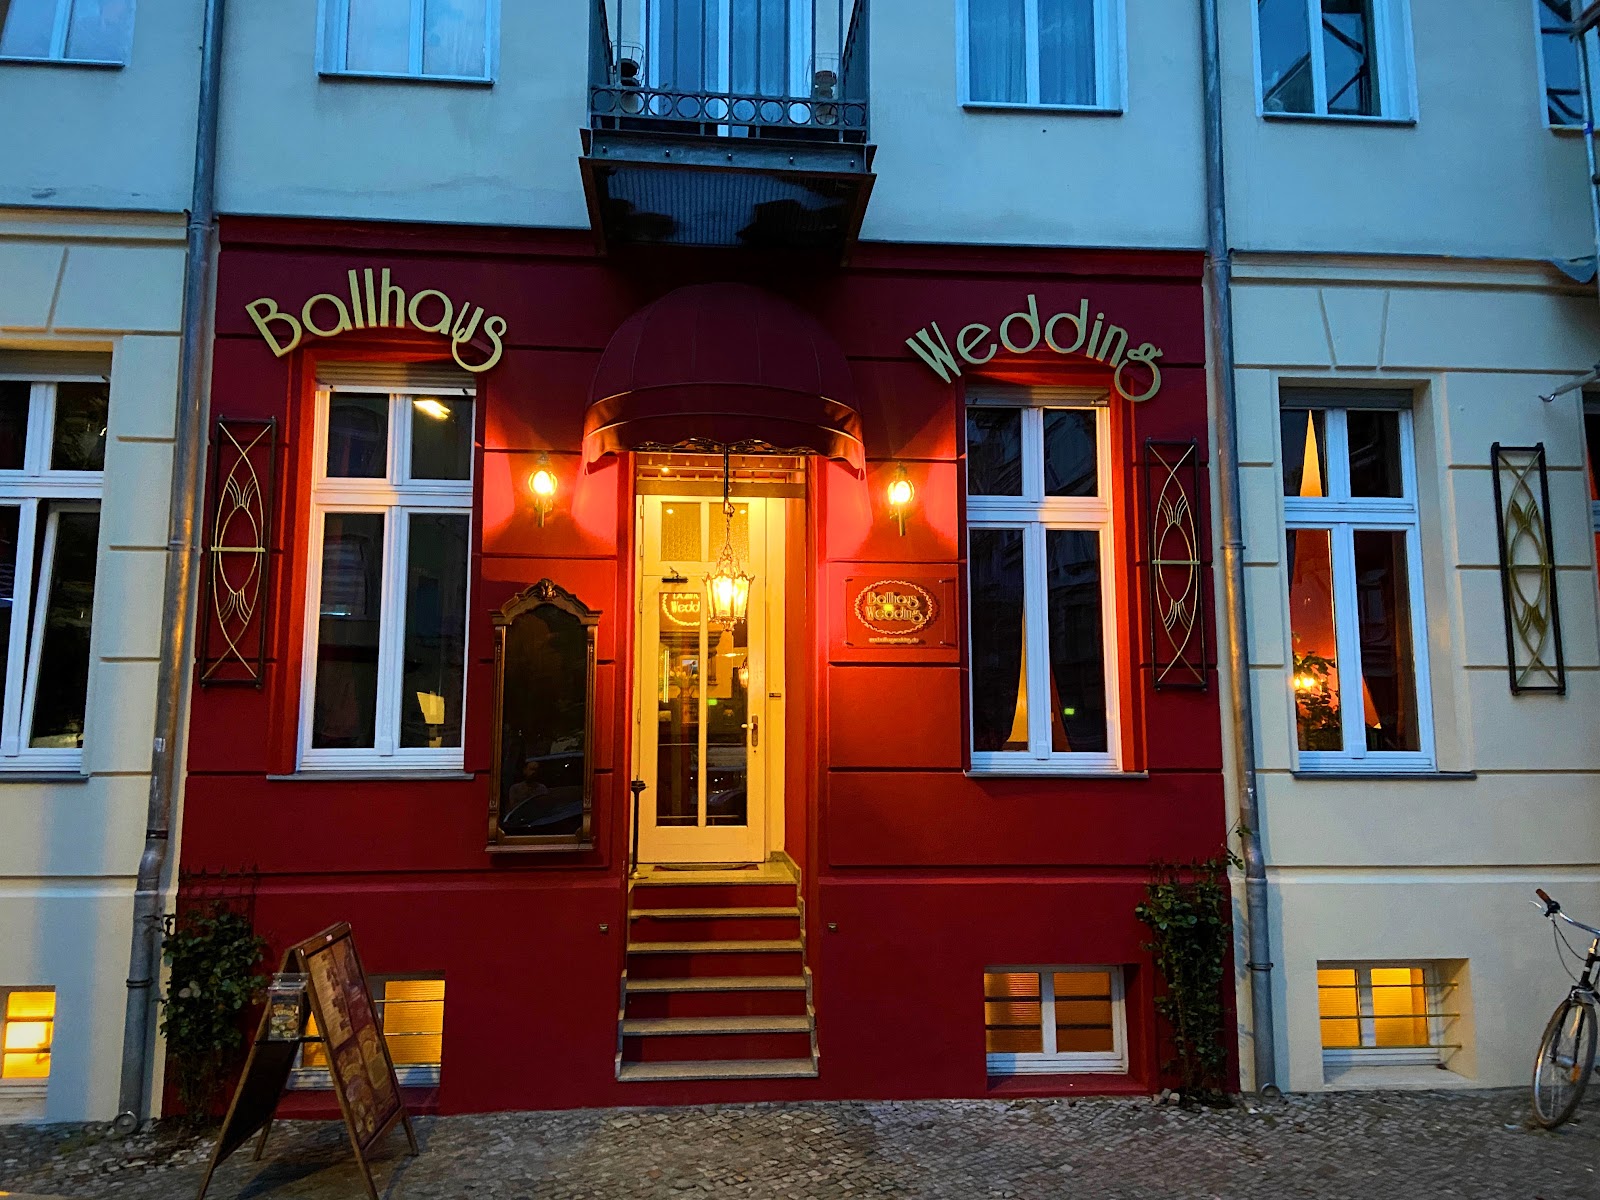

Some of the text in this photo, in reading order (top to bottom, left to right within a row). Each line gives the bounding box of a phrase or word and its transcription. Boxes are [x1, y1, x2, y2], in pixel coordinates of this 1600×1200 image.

[245, 268, 507, 373] Ballhaus
[905, 294, 1164, 402] Wedding
[866, 591, 919, 609] Ballhaus
